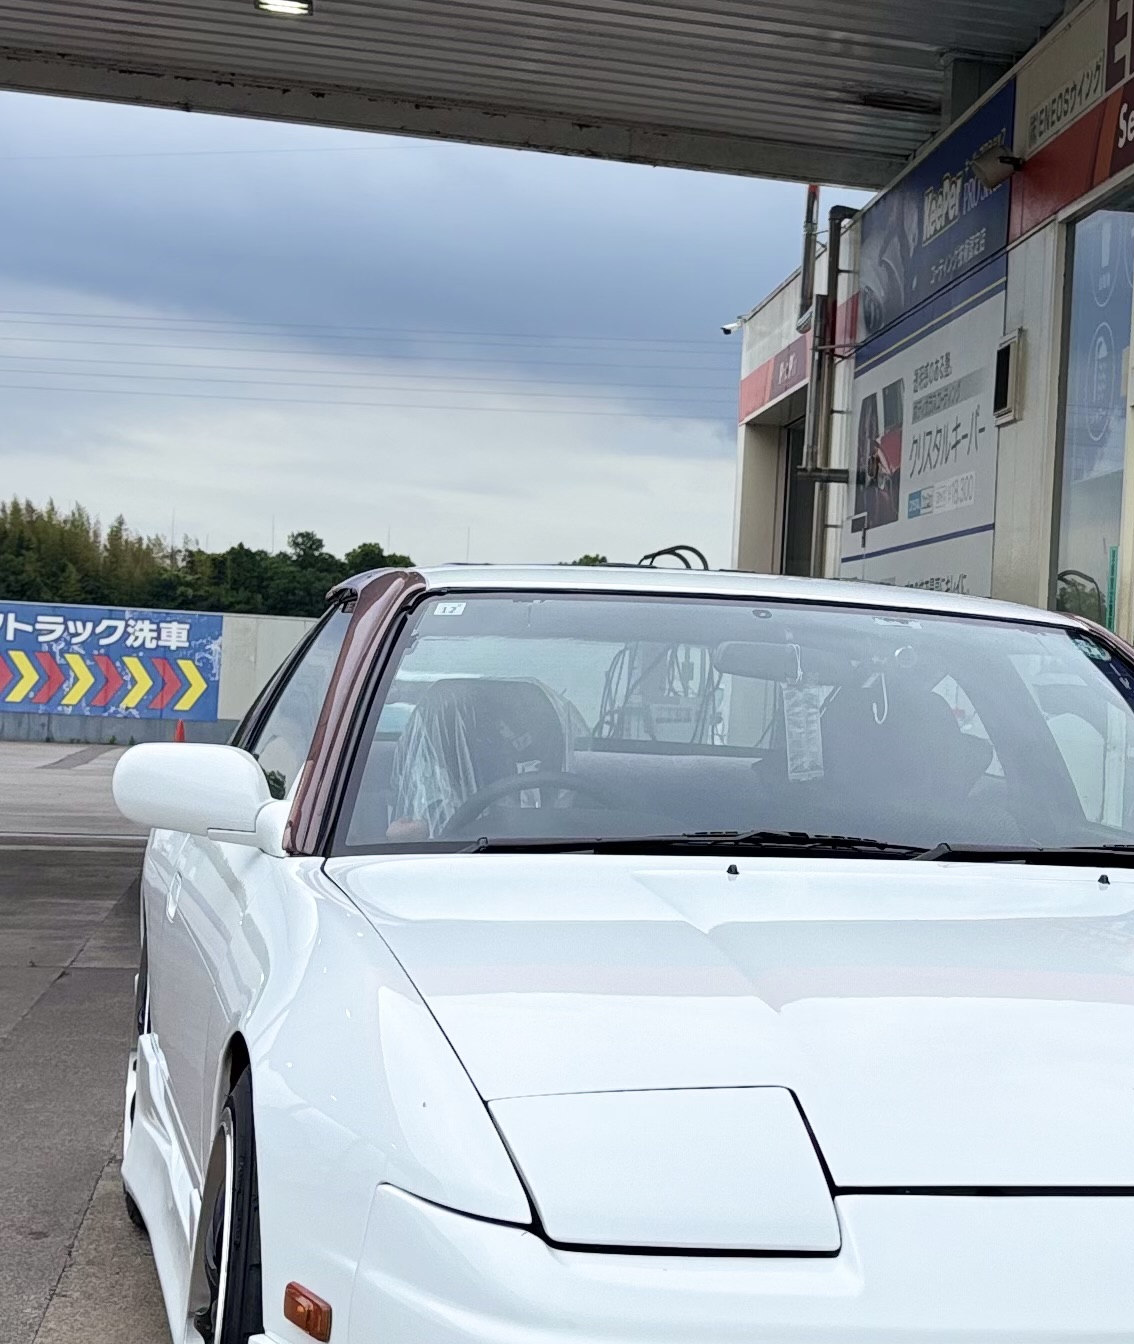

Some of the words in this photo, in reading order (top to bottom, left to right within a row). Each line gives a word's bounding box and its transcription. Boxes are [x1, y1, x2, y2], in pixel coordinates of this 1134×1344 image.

[909, 404, 986, 479] クリスタルキーパー
[0, 612, 190, 650] トラック洗車
